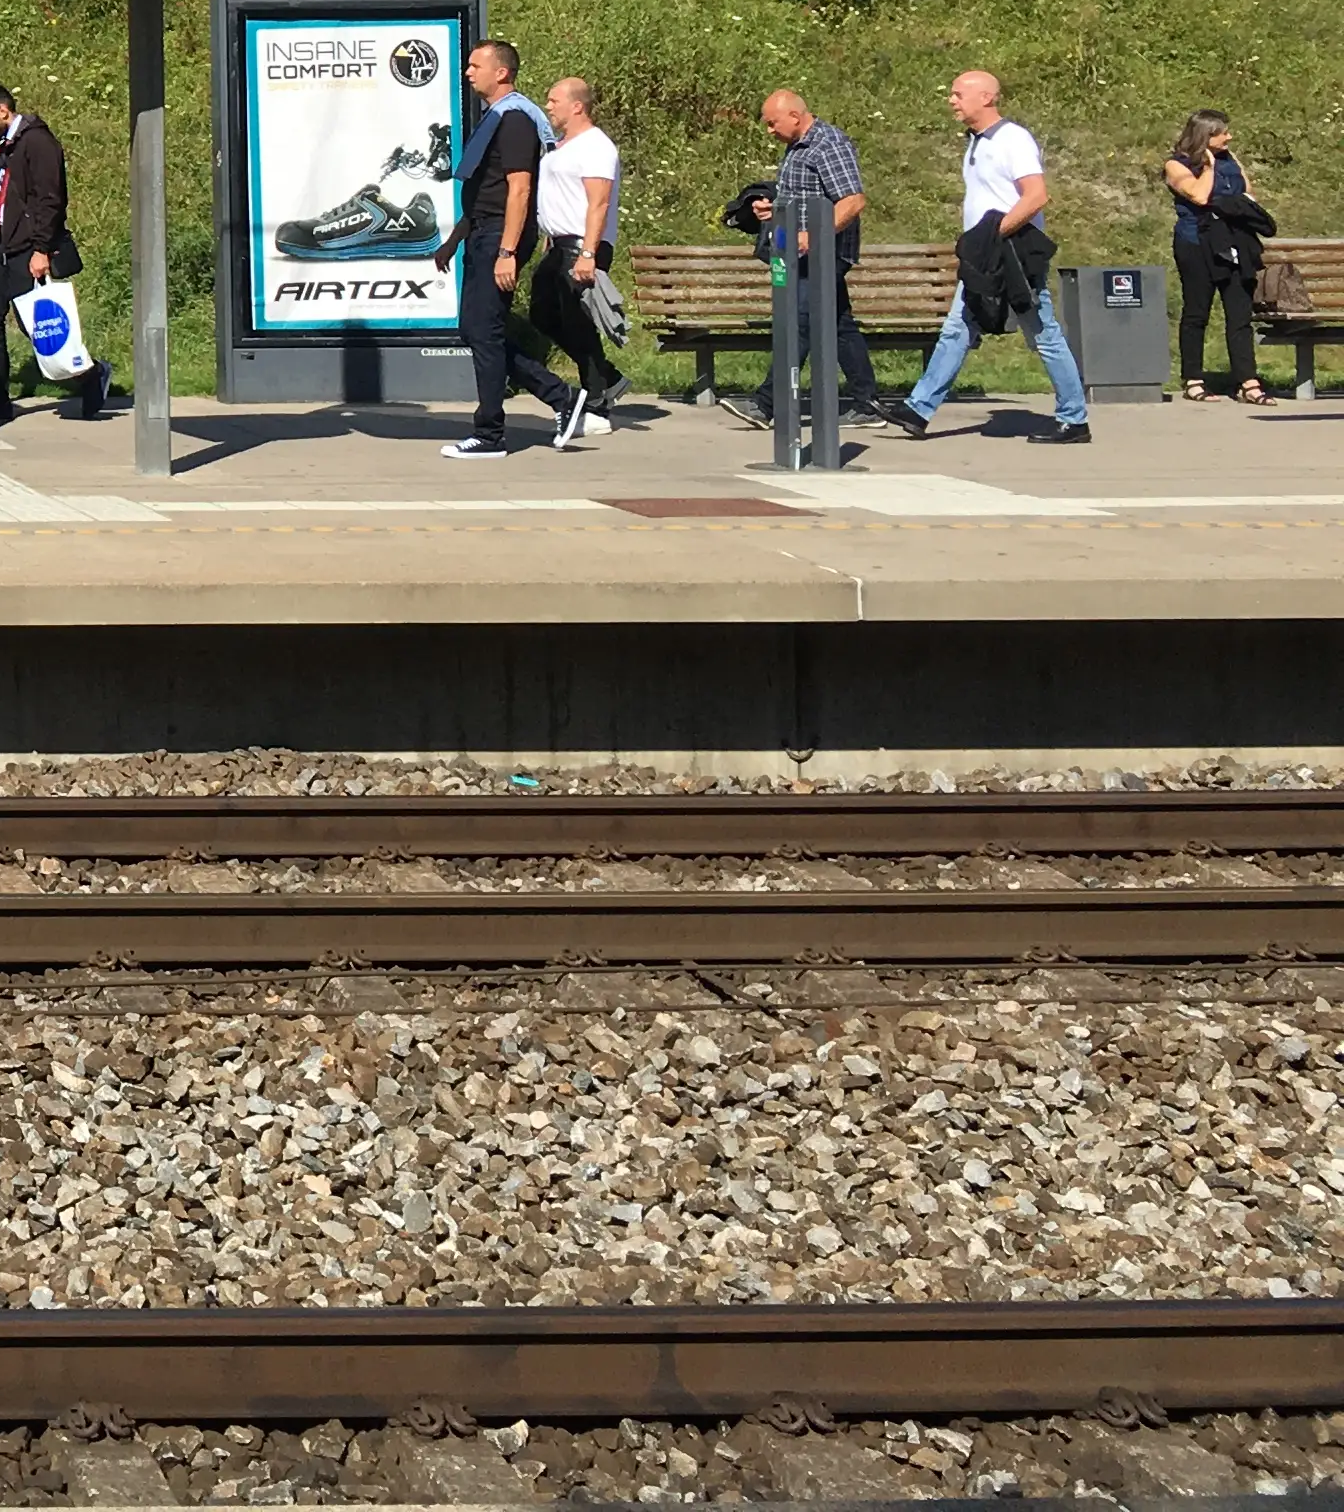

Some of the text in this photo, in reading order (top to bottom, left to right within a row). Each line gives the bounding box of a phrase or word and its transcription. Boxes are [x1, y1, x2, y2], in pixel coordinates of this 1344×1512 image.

[267, 40, 376, 61] INSANE
[267, 63, 377, 80] COMFORT
[313, 211, 373, 235] AIRTOX
[274, 280, 434, 302] AIRTOX
